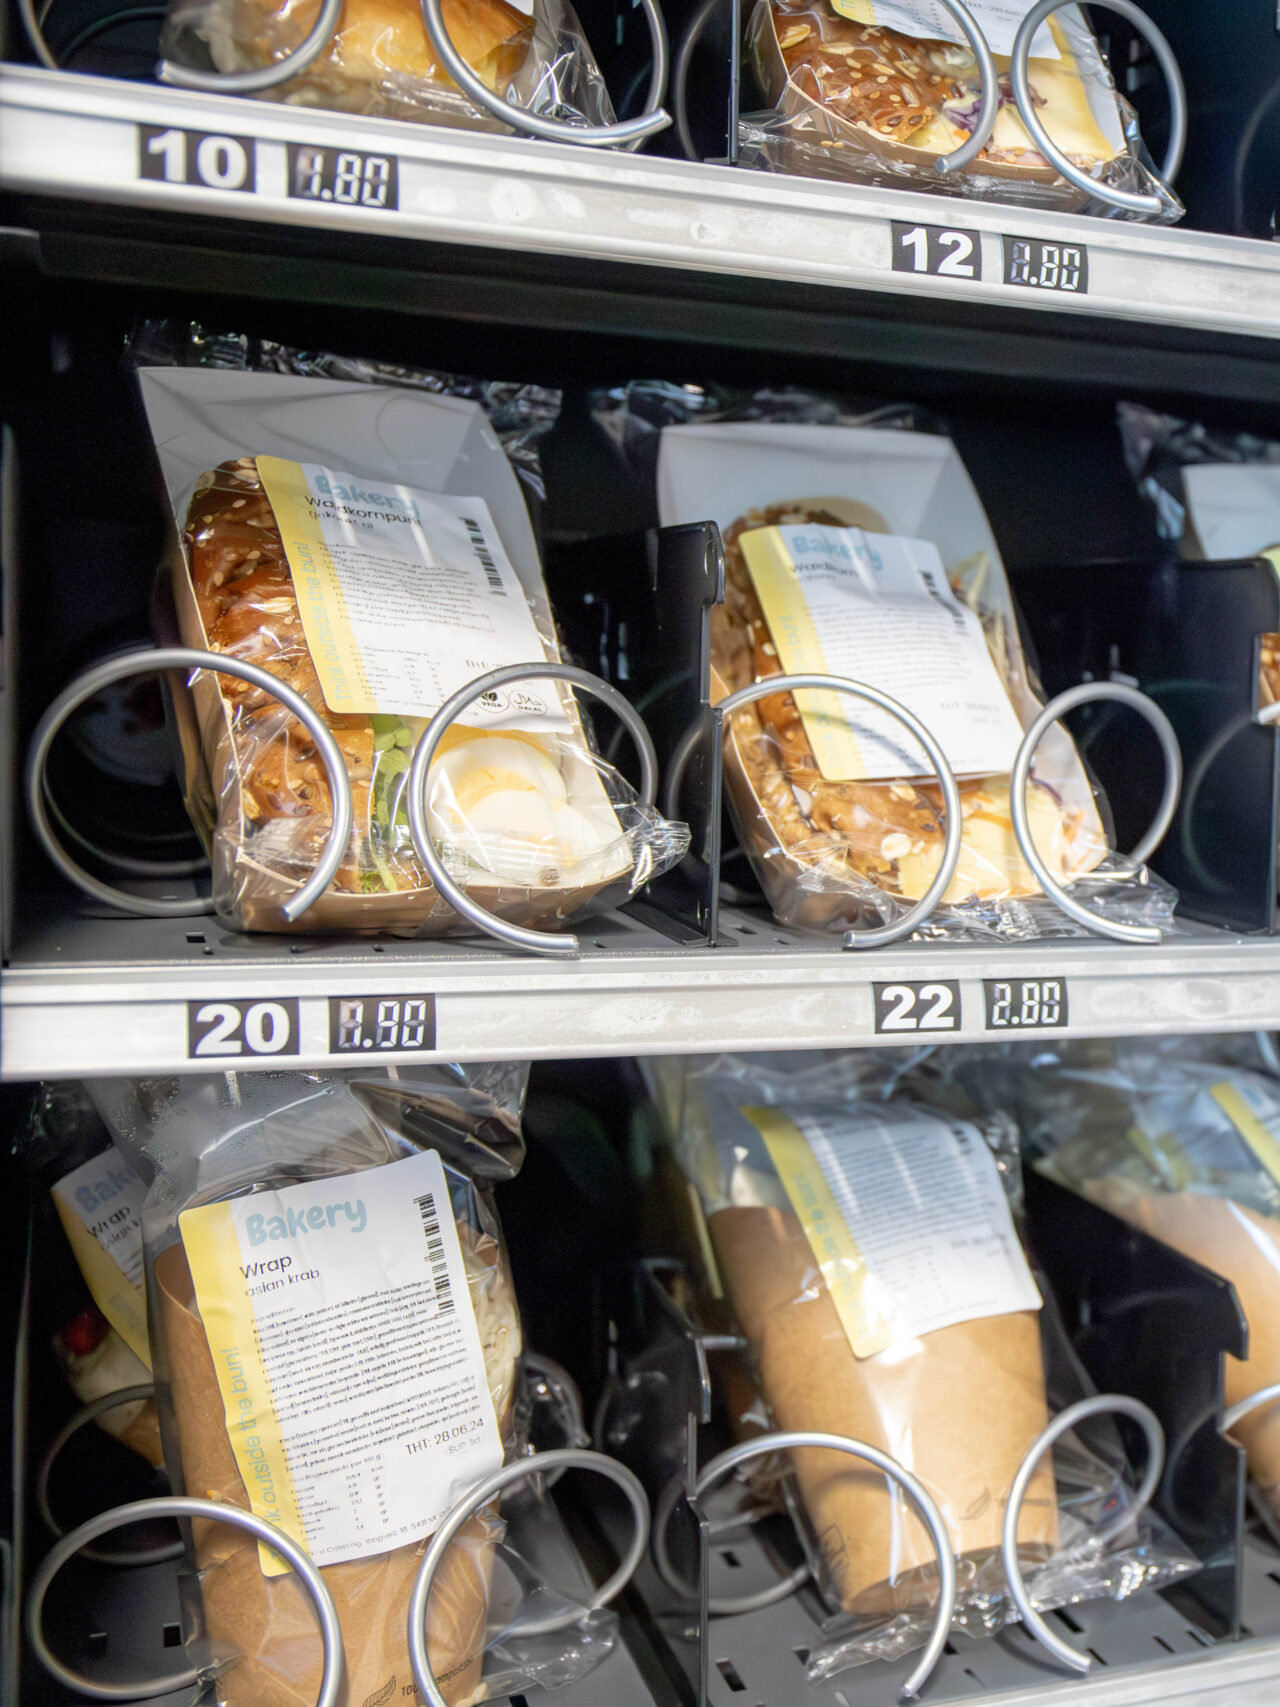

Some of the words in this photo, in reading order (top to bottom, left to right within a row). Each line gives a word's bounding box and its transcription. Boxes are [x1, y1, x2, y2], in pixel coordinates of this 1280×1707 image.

[148, 130, 248, 190] 10
[302, 146, 390, 206] 1.80
[901, 227, 974, 276] 12
[1013, 242, 1080, 290] 1.80
[304, 495, 423, 528] Wadkornpunt
[314, 474, 420, 520] Bakery
[293, 541, 317, 573] bun!
[305, 577, 323, 601] the
[312, 606, 339, 662] outside
[328, 664, 352, 701] Think
[195, 1003, 290, 1055] 20
[342, 1000, 426, 1049] 1.90
[881, 985, 954, 1030] 22
[86, 1206, 131, 1237] Wrap
[245, 1199, 367, 1247] Bakery
[239, 1256, 292, 1279] Wrap
[245, 1279, 284, 1297] asian
[288, 1269, 320, 1285] krab
[221, 1347, 248, 1394] bun!
[236, 1398, 256, 1431] the
[406, 1438, 433, 1455] THT:
[434, 1418, 484, 1446] 28.06.24
[245, 1436, 277, 1504] outside
